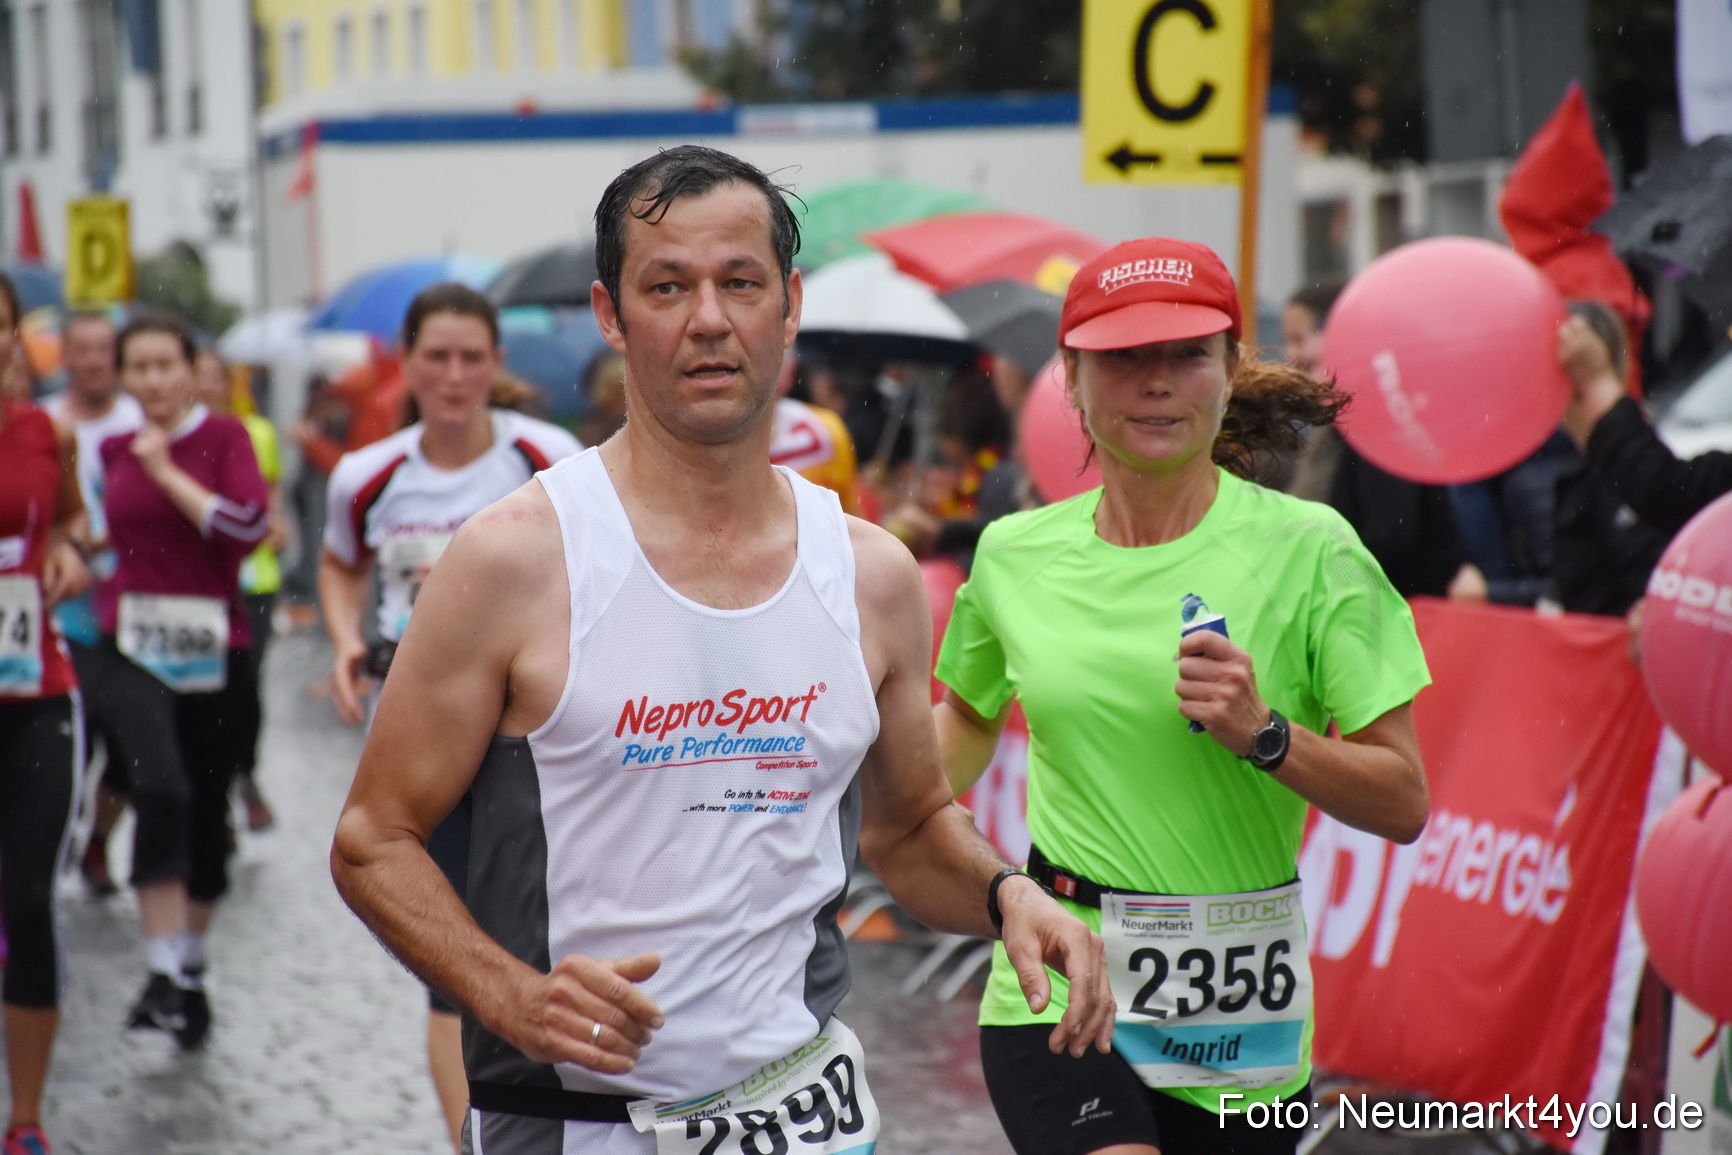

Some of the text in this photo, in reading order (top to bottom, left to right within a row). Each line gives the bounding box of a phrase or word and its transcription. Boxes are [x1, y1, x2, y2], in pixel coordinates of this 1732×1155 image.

[1134, 0, 1214, 121] C
[1097, 257, 1193, 288] FISCHER
[622, 732, 806, 765] Pure Performance
[755, 760, 818, 771] Competition Sports
[724, 789, 736, 799] Go
[738, 790, 753, 799] into
[755, 789, 766, 799] the
[767, 790, 796, 800] ACTIVE
[728, 804, 755, 812] POWER
[755, 804, 770, 812] and
[1122, 894, 1292, 932] NeuerMarkt BOCK
[1128, 939, 1296, 1019] 2356
[1161, 1034, 1242, 1064] Ingrid
[746, 1083, 777, 1105] inspired
[777, 1078, 787, 1090] by
[806, 1040, 837, 1066] concepts
[686, 1054, 864, 1155] 2899
